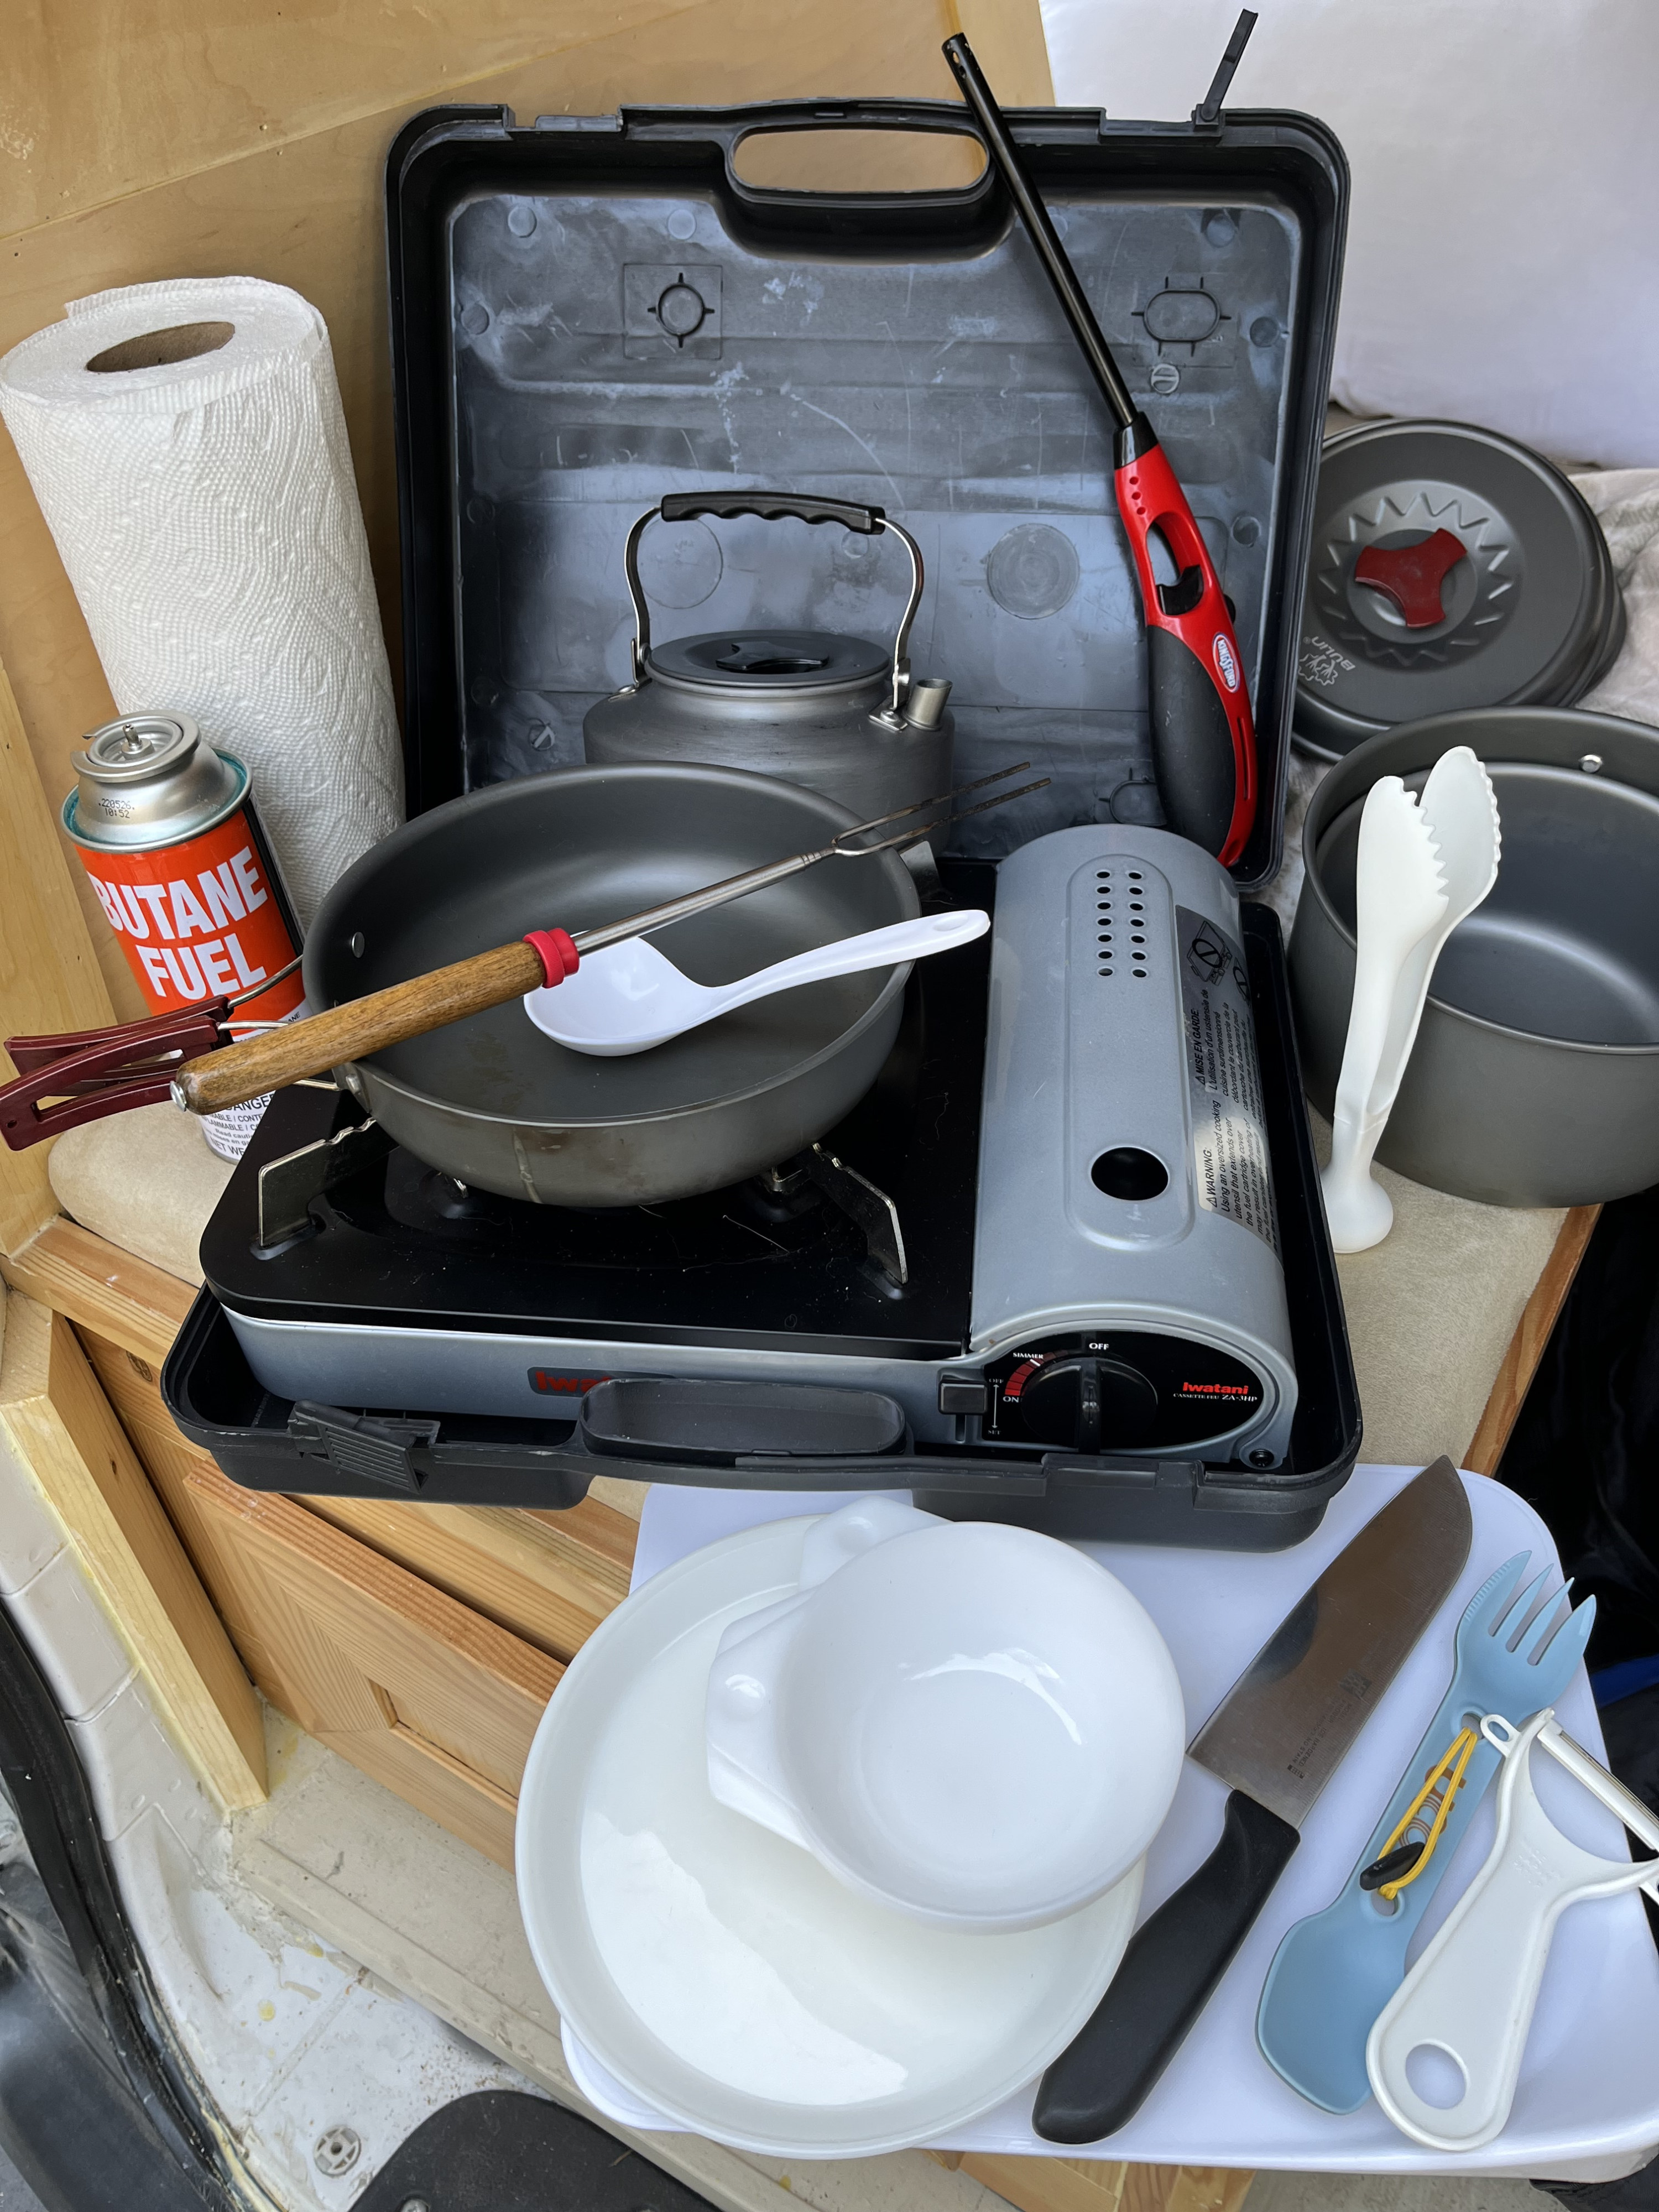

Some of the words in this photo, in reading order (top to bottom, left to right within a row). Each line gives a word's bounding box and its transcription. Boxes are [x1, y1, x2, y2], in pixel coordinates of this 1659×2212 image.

[1217, 639, 1236, 687] KINGSFORD
[105, 807, 131, 819] 10:52
[86, 846, 268, 940] BUTANE
[135, 932, 267, 1000] FUEL
[1201, 989, 1207, 998] de
[1201, 1000, 1211, 1031] ustensile
[1223, 1010, 1230, 1020] de
[1193, 1041, 1202, 1052] EN
[1205, 1032, 1213, 1047] d'un
[1213, 1011, 1226, 1068] surdimensionné
[1233, 1026, 1242, 1061] carburant
[1194, 1053, 1204, 1074] MISE
[1206, 1049, 1217, 1090] L'utilisation
[1237, 1061, 1244, 1072] du
[1220, 1070, 1229, 1096] cuisine
[1228, 1064, 1239, 1103] débordant
[1238, 1073, 1248, 1110] cartouche
[226, 1093, 275, 1111] ANGE
[238, 1113, 263, 1123] CONTE
[1211, 1099, 1222, 1130] cooking
[1243, 1118, 1251, 1129] of
[210, 1136, 227, 1152] NET
[1213, 1131, 1225, 1172] oversized
[1226, 1138, 1237, 1170] extends
[1237, 1130, 1245, 1154] cover
[1245, 1130, 1256, 1177] overheating
[1203, 1147, 1215, 1195] WARNING:
[1219, 1175, 1227, 1185] an
[1230, 1171, 1239, 1188] that
[1239, 1155, 1249, 1192] cartridge
[1250, 1179, 1258, 1187] in
[1220, 1186, 1230, 1212] Using
[1242, 1193, 1252, 1210] fuel
[1251, 1188, 1260, 1212] result
[1258, 1172, 1267, 1208] canister
[1232, 1190, 1243, 1219] utensil
[1260, 1208, 1269, 1225] fuel
[1244, 1212, 1254, 1226] the
[1255, 1214, 1264, 1234] may
[1182, 1382, 1249, 1395] Iwatani
[1222, 1394, 1258, 1402] ZA-3HP
[1297, 1737, 1321, 1768] HARDENED
